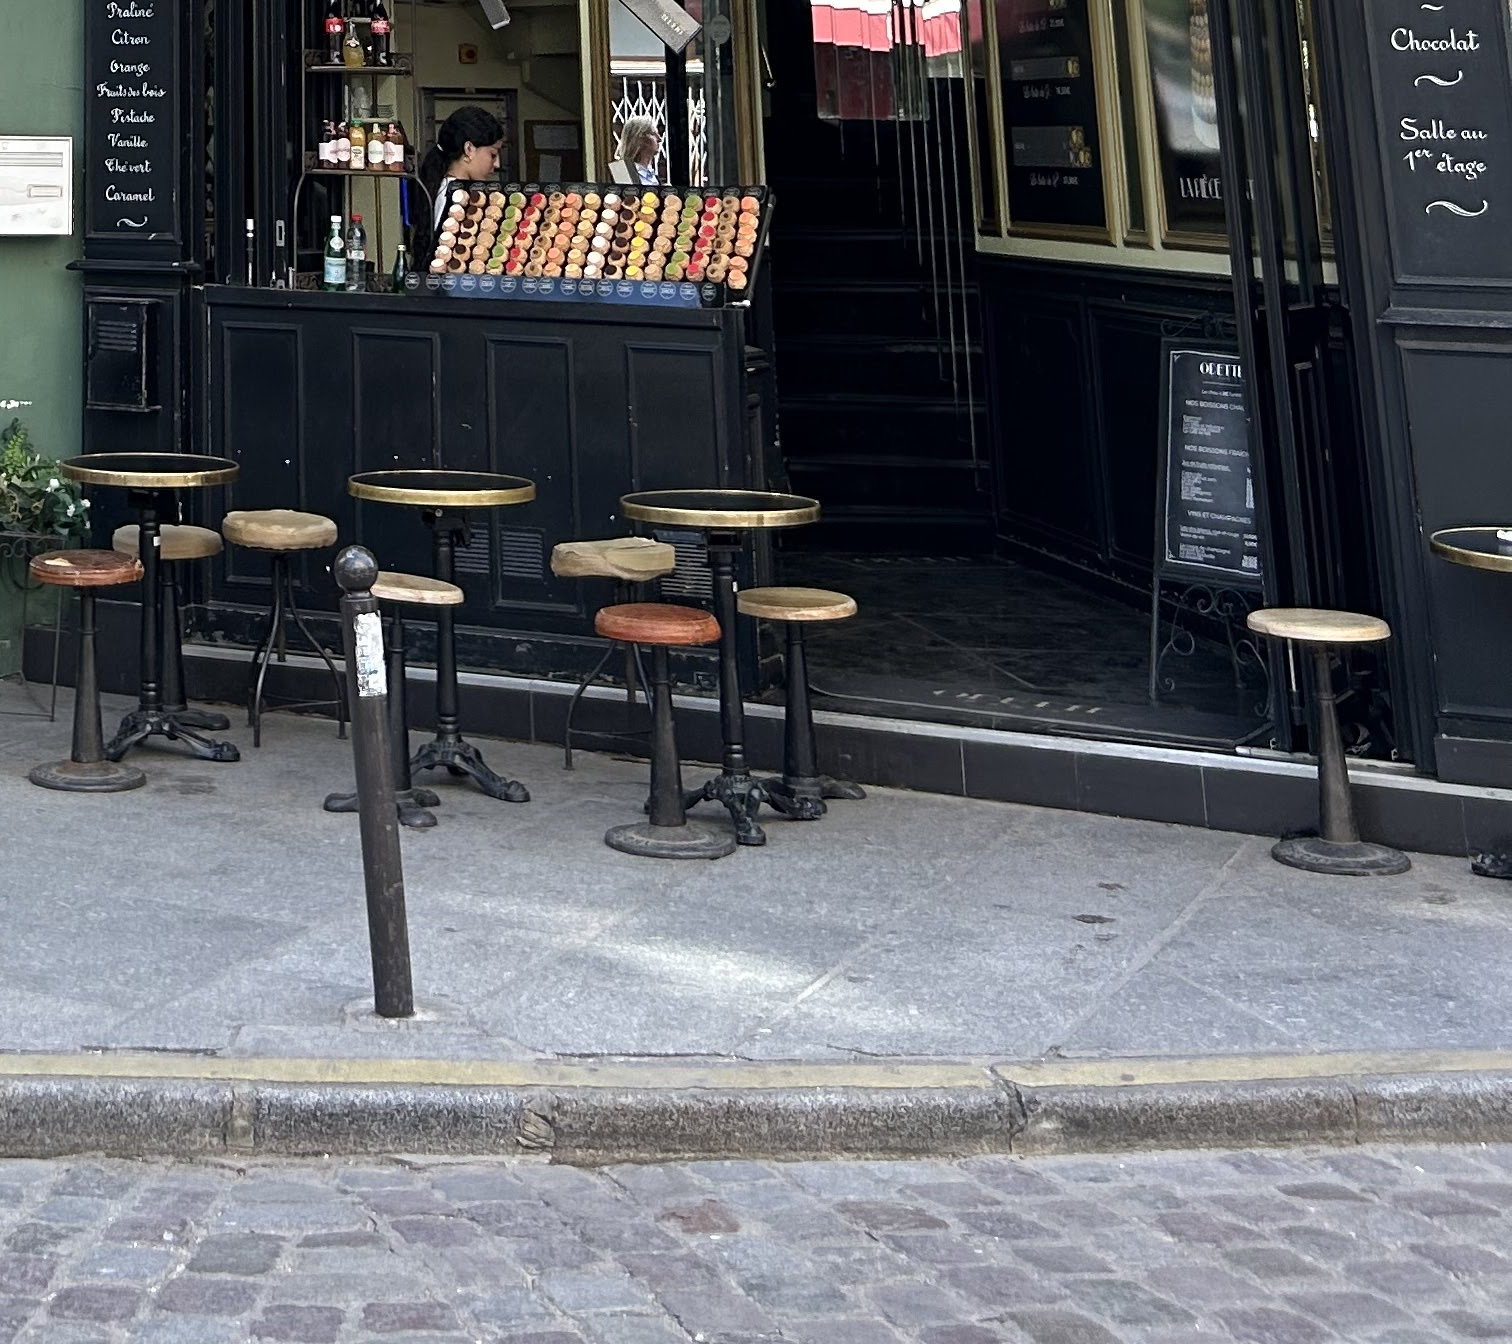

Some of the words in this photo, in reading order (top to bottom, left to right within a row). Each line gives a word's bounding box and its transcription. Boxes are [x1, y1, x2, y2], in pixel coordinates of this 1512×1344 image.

[106, 0, 154, 19] Praliné
[111, 28, 150, 45] Citron
[1390, 27, 1480, 52] Chocolat
[110, 59, 151, 78] Orange
[96, 81, 127, 98] Fruits
[128, 86, 141, 97] des
[142, 81, 167, 98] bois
[110, 107, 156, 124] Pistache
[1400, 117, 1457, 141] Salle
[1460, 129, 1488, 140] au
[107, 132, 149, 148] Vanille
[104, 157, 128, 173] Thé
[129, 159, 152, 173] vert
[1402, 147, 1434, 171] 1er
[1436, 152, 1487, 180] étage
[105, 184, 156, 202] Caramel
